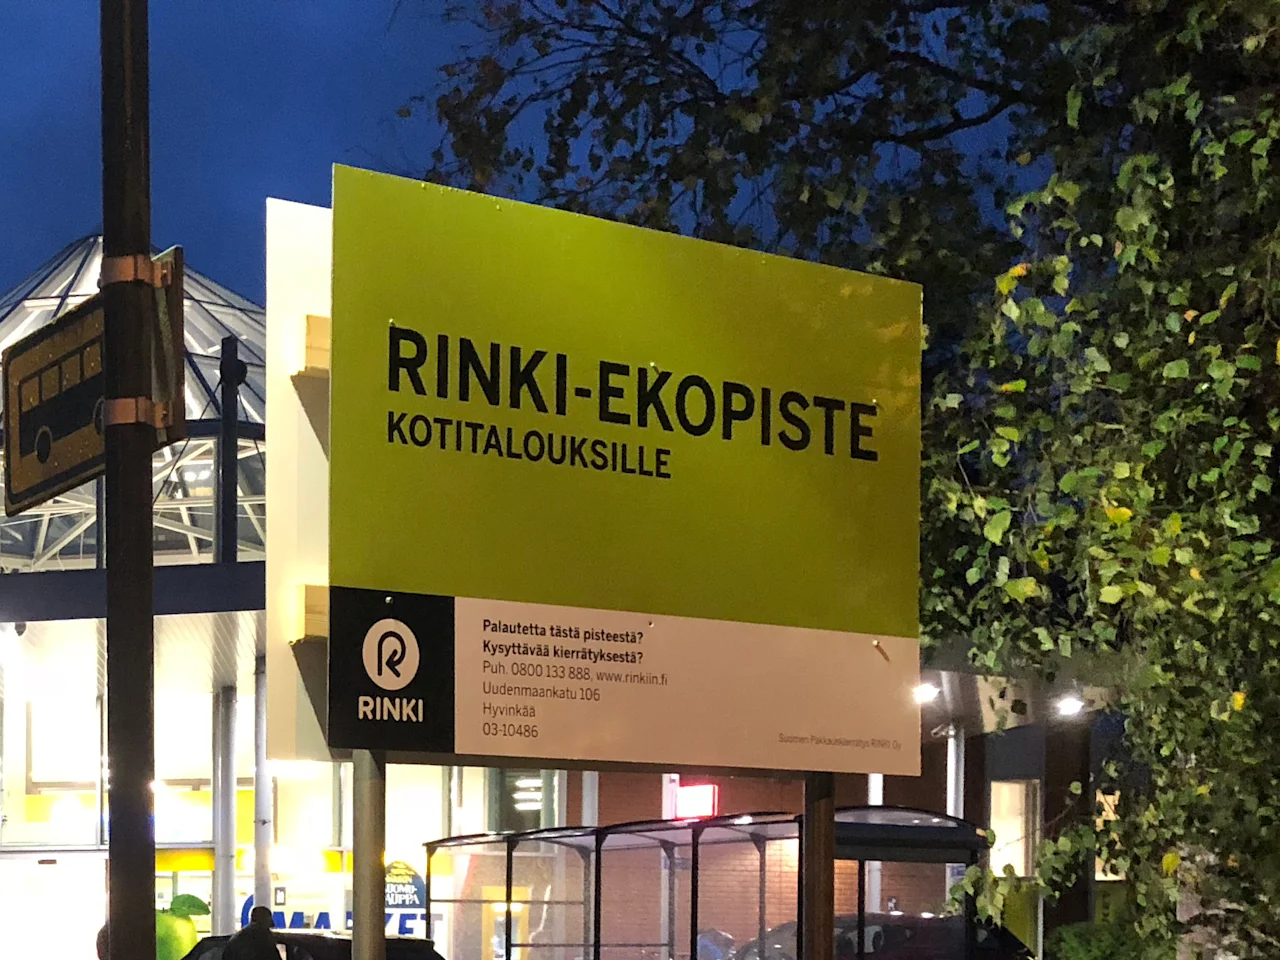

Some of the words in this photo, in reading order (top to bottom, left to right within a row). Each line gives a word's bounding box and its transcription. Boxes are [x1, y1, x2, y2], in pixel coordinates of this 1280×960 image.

[388, 326, 878, 462] RINKI-EKOPISTE
[388, 410, 671, 480] KOTITALOUKSILLE
[482, 619, 547, 637] Palautetta
[549, 625, 580, 639] tästä
[583, 629, 644, 645] pisteestä?
[482, 640, 550, 658] Kysyttävää
[553, 645, 644, 664] kierrätyksestä?
[483, 660, 508, 676] Puh.
[511, 662, 543, 677] 0800
[546, 664, 566, 679] 133
[569, 666, 594, 682] 888,
[596, 671, 668, 686] www.rinkiin.fi
[483, 682, 577, 700] Uudenmaankatu
[580, 688, 601, 701] 106
[358, 695, 424, 723] RINKI
[483, 702, 536, 719] Hyvinkää
[483, 722, 539, 738] 03-10486
[778, 732, 809, 745] Suomen
[385, 883, 417, 894] UOMU-
[385, 893, 420, 905] AUPPA
